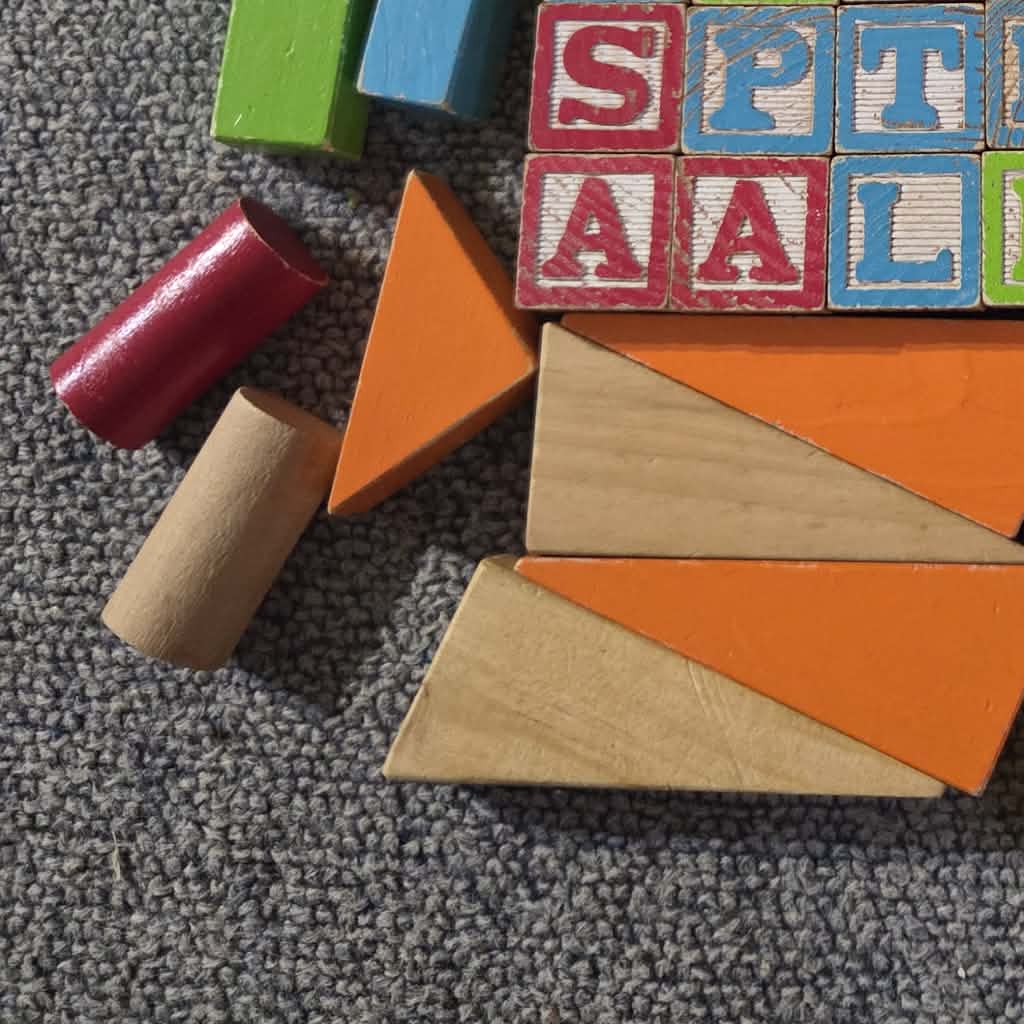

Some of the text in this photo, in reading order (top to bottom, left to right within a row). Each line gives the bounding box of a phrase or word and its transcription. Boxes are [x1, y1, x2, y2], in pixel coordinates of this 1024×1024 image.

[558, 26, 654, 125] S
[708, 26, 812, 130] P
[861, 27, 960, 129] T
[541, 177, 644, 278] A
[699, 180, 800, 282] A
[856, 183, 953, 282] L
